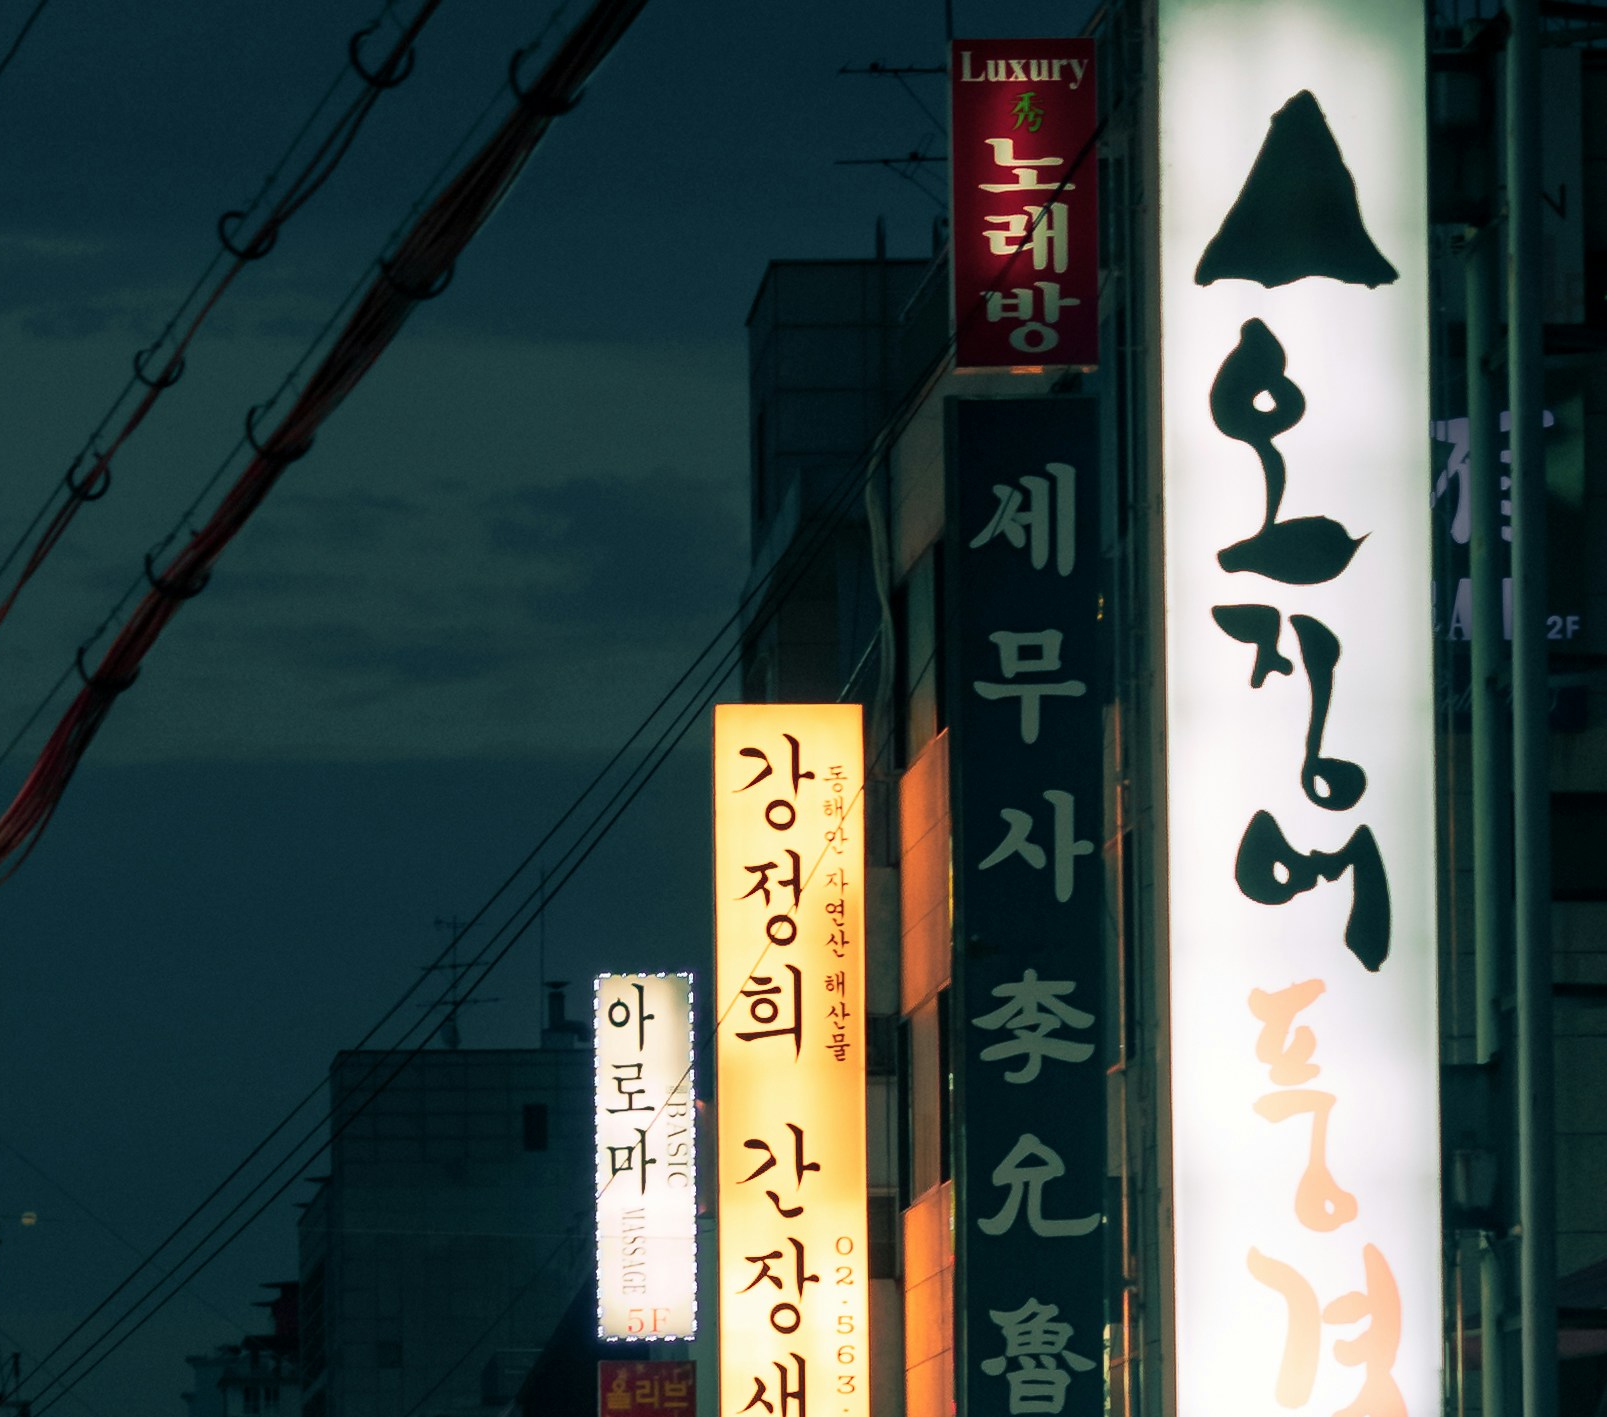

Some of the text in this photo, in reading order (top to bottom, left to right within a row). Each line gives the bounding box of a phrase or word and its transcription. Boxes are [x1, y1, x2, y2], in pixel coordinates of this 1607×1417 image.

[959, 50, 1090, 91] Luxury
[1009, 92, 1045, 133] 秀
[978, 138, 1080, 354] 노래방
[970, 462, 1094, 904] 세무사
[1210, 317, 1392, 973] 오징어
[1545, 614, 1581, 640] 2F
[732, 733, 815, 1063] 강정희
[823, 765, 851, 1063] 동해안 자연산 해산물
[606, 983, 656, 1197] 아로마
[972, 968, 1102, 1415] 李允魯
[626, 1306, 671, 1334] 5F
